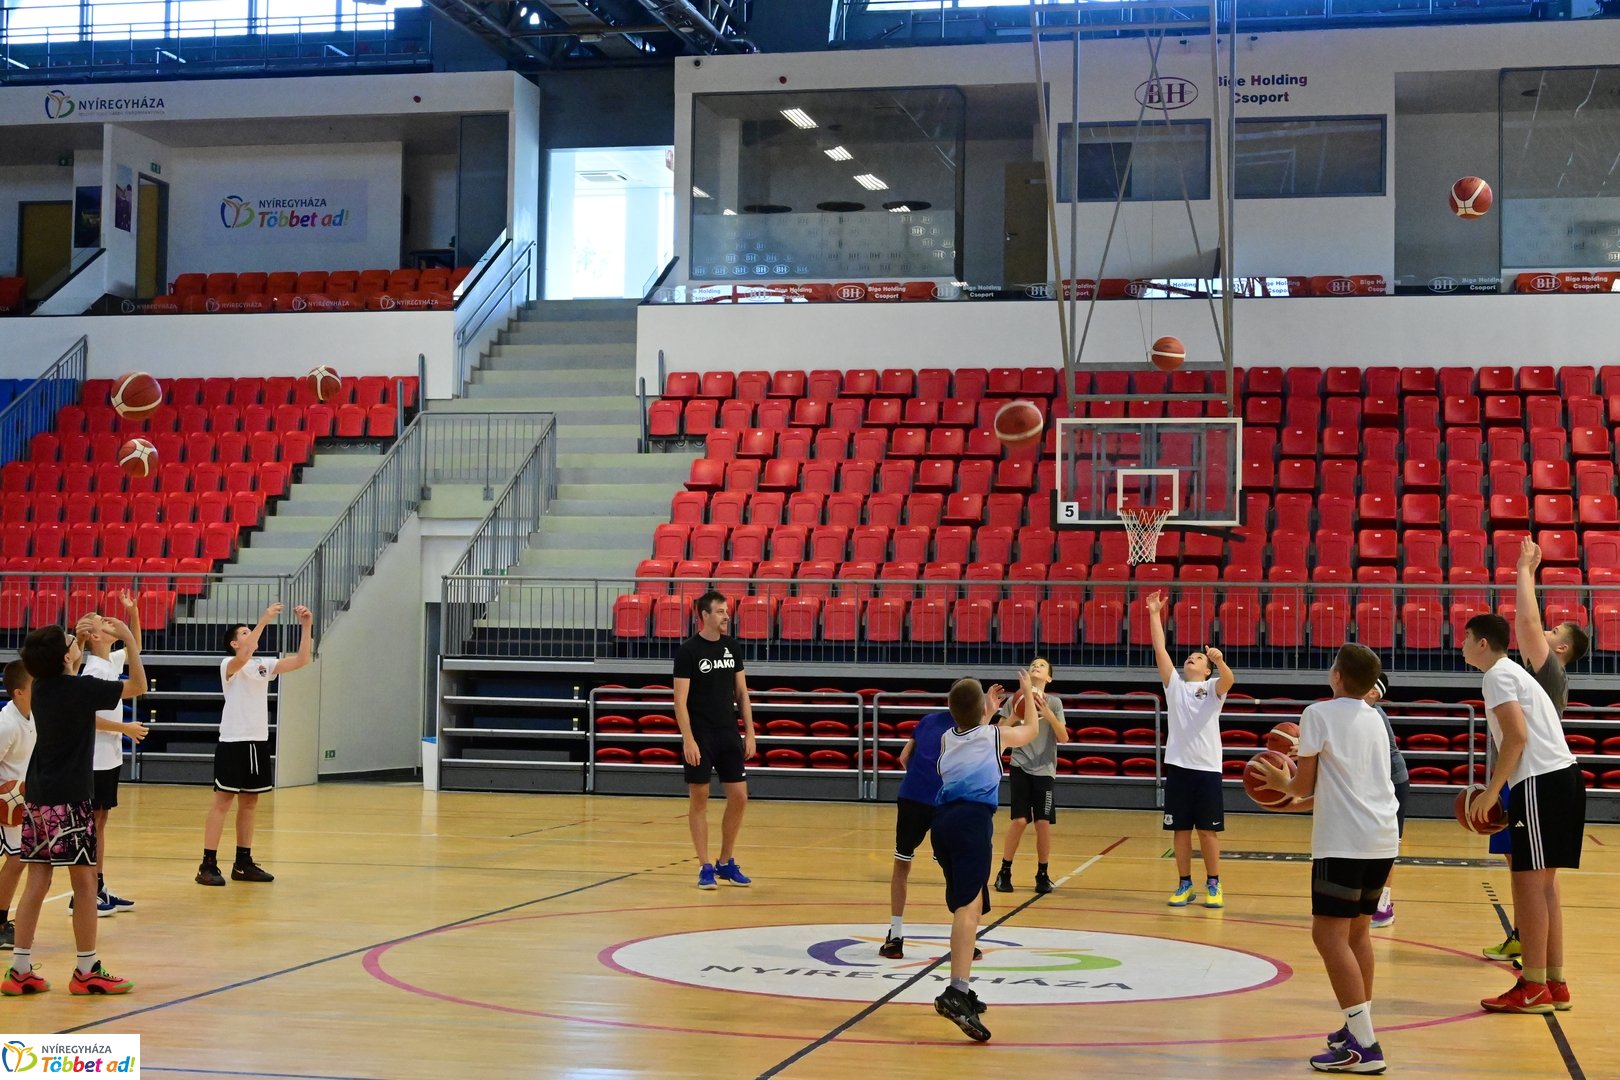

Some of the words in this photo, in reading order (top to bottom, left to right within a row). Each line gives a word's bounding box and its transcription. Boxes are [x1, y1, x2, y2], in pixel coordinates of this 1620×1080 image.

[1218, 76, 1246, 88] ie
[1250, 74, 1308, 87] Holding
[78, 96, 165, 110] NYÍREGYHÁZA
[259, 197, 327, 208] NYÍREGYHÁZA
[258, 210, 318, 228] Többet
[321, 208, 350, 226] ad!
[1332, 281, 1351, 291] BH
[1433, 279, 1452, 290] BH
[1537, 278, 1556, 288] BH
[842, 288, 859, 298] BH
[1031, 286, 1048, 295] BH
[1065, 505, 1074, 517] 5
[713, 659, 735, 669] JAKO
